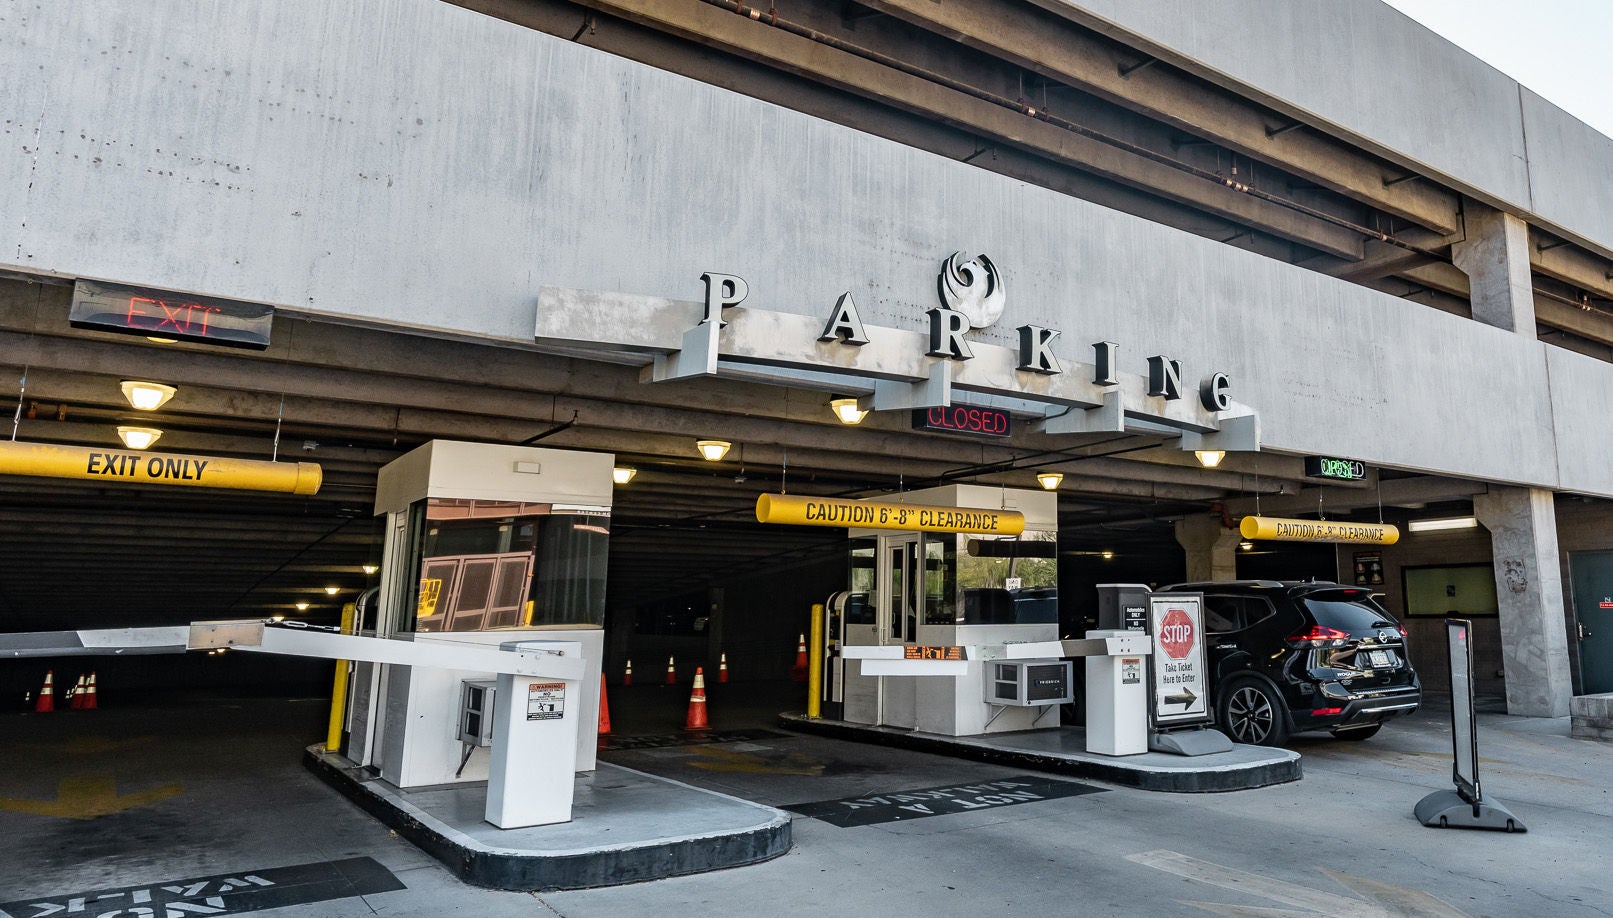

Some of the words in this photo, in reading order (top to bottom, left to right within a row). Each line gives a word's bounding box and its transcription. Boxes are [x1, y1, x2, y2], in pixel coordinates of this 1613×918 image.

[127, 297, 221, 337] EXIT
[700, 271, 1232, 413] PARKING
[928, 405, 1007, 433] CLOSED
[87, 453, 141, 477] EXIT
[147, 457, 208, 480] ONLY
[805, 503, 875, 524] CAUTION
[919, 510, 999, 531] CLEARANCE
[1277, 523, 1315, 538] CAUTION
[1339, 527, 1384, 541] CLEARANCE
[1163, 624, 1191, 643] STOP
[1163, 675, 1175, 684] Here
[1176, 675, 1182, 683] to
[1182, 674, 1196, 683] Enter
[1165, 663, 1177, 673] Take
[1178, 662, 1193, 672] Ticket
[839, 781, 1033, 810] WALKWAY
[951, 790, 1045, 809] NOT
[898, 803, 935, 814] A
